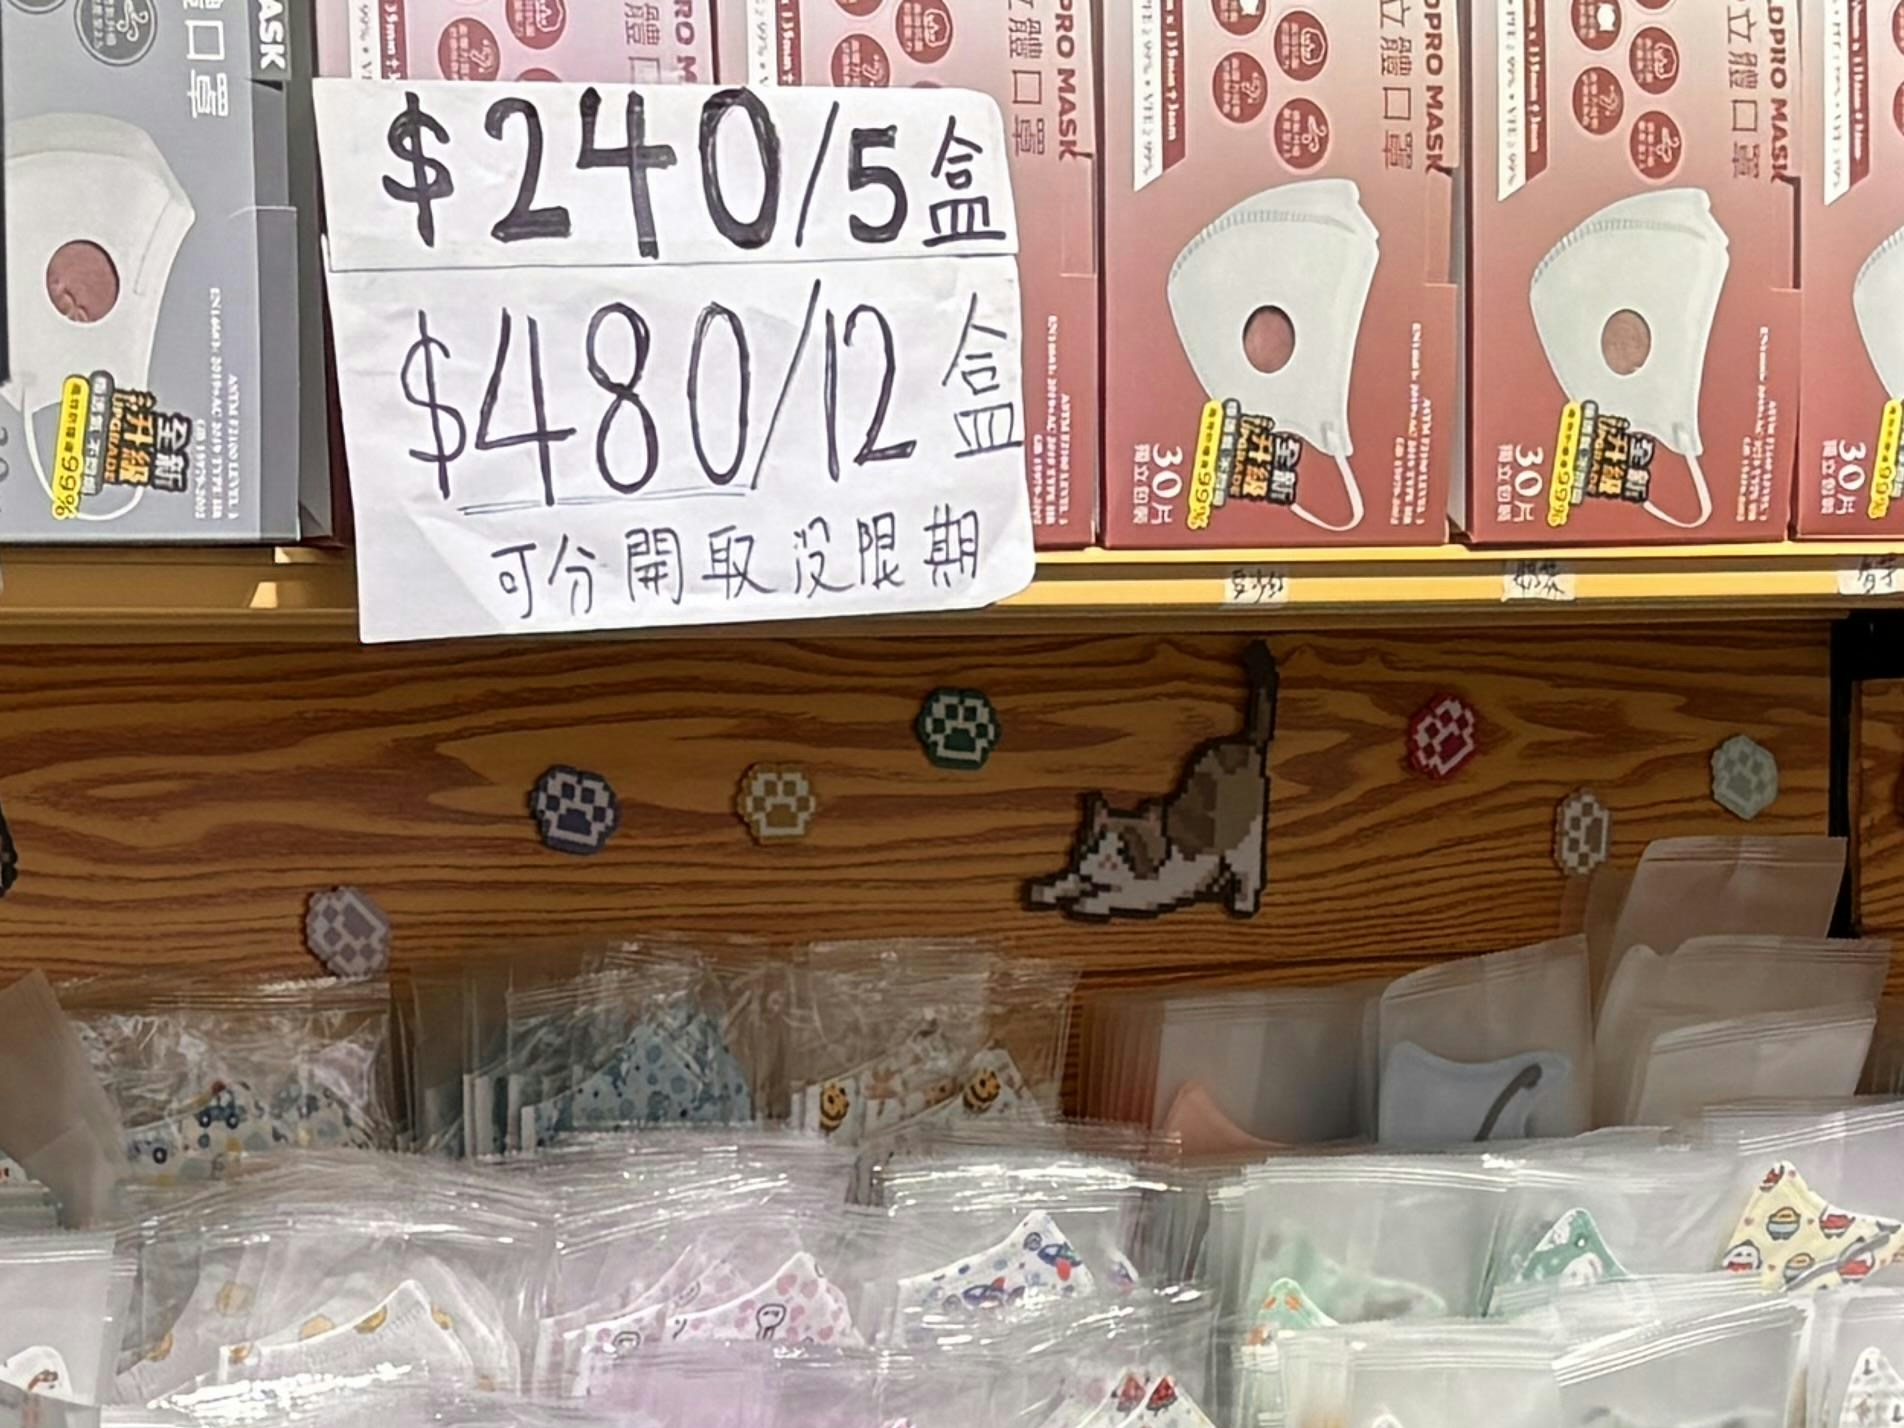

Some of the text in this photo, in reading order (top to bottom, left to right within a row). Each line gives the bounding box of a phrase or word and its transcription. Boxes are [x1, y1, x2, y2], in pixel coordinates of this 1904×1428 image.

[382, 86, 1007, 259] $240/5盒
[401, 278, 1024, 508] $480/12盒
[119, 414, 153, 483] 升級
[155, 416, 189, 489] 全新
[1151, 443, 1183, 524] 30片
